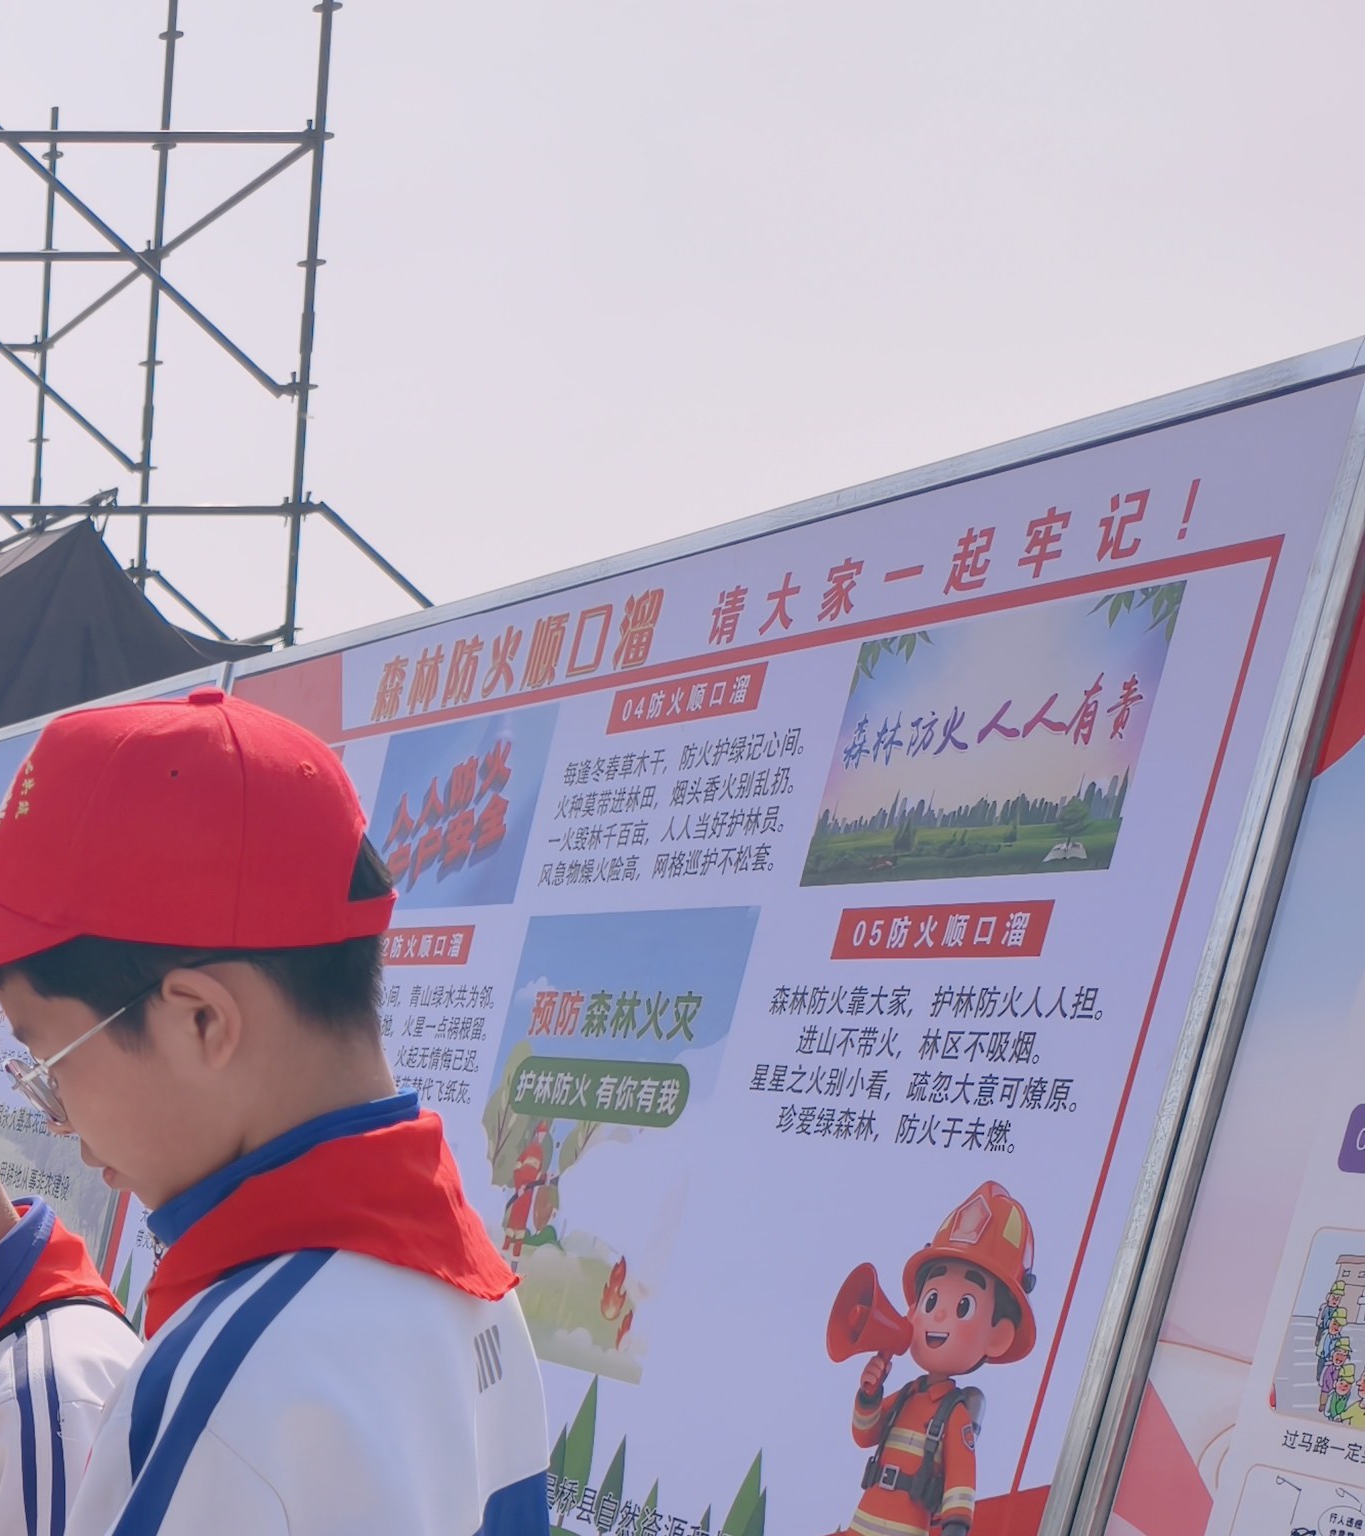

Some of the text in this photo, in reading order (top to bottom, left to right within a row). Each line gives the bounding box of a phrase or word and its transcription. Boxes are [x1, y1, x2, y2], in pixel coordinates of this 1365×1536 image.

[370, 478, 1201, 722] 森林防火顺口溜 请大家一起牢记！
[622, 674, 752, 722] 04防火顺口溜
[381, 739, 512, 855] 人人防火
[380, 932, 464, 959] 2防火顺口溜
[851, 911, 1032, 949] 05防火顺口溜
[527, 989, 703, 1042] 预防森林火灾
[514, 1068, 681, 1116] 护林防火 有你有我
